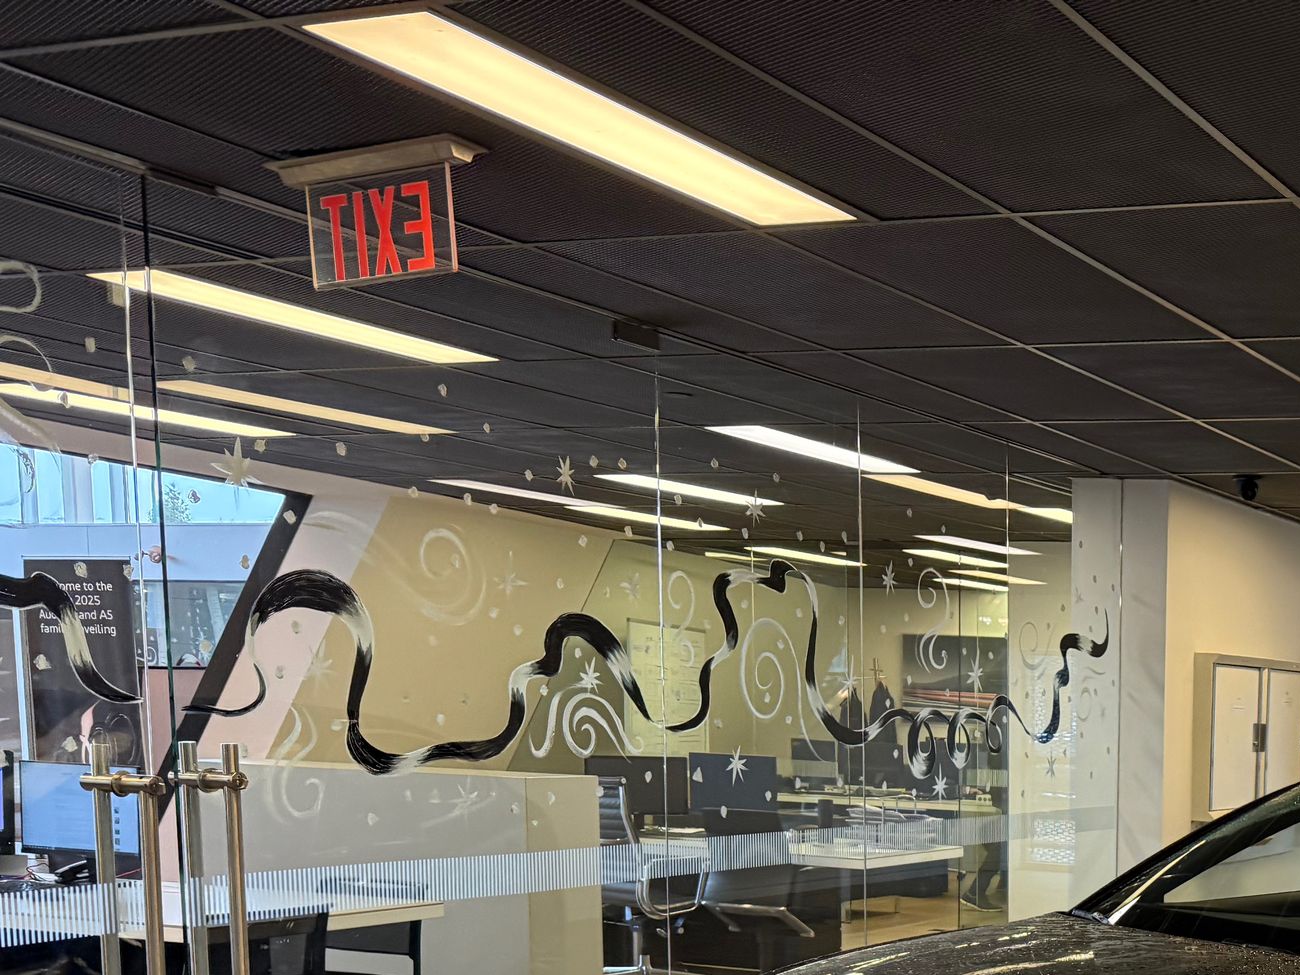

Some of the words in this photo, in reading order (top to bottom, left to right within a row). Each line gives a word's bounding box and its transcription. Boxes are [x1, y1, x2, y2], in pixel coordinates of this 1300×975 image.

[83, 582, 94, 591] to
[96, 581, 113, 591] the
[74, 595, 101, 605] 2025
[79, 610, 97, 620] and
[99, 609, 113, 620] A5
[40, 623, 62, 633] fami
[84, 624, 116, 636] veiling
